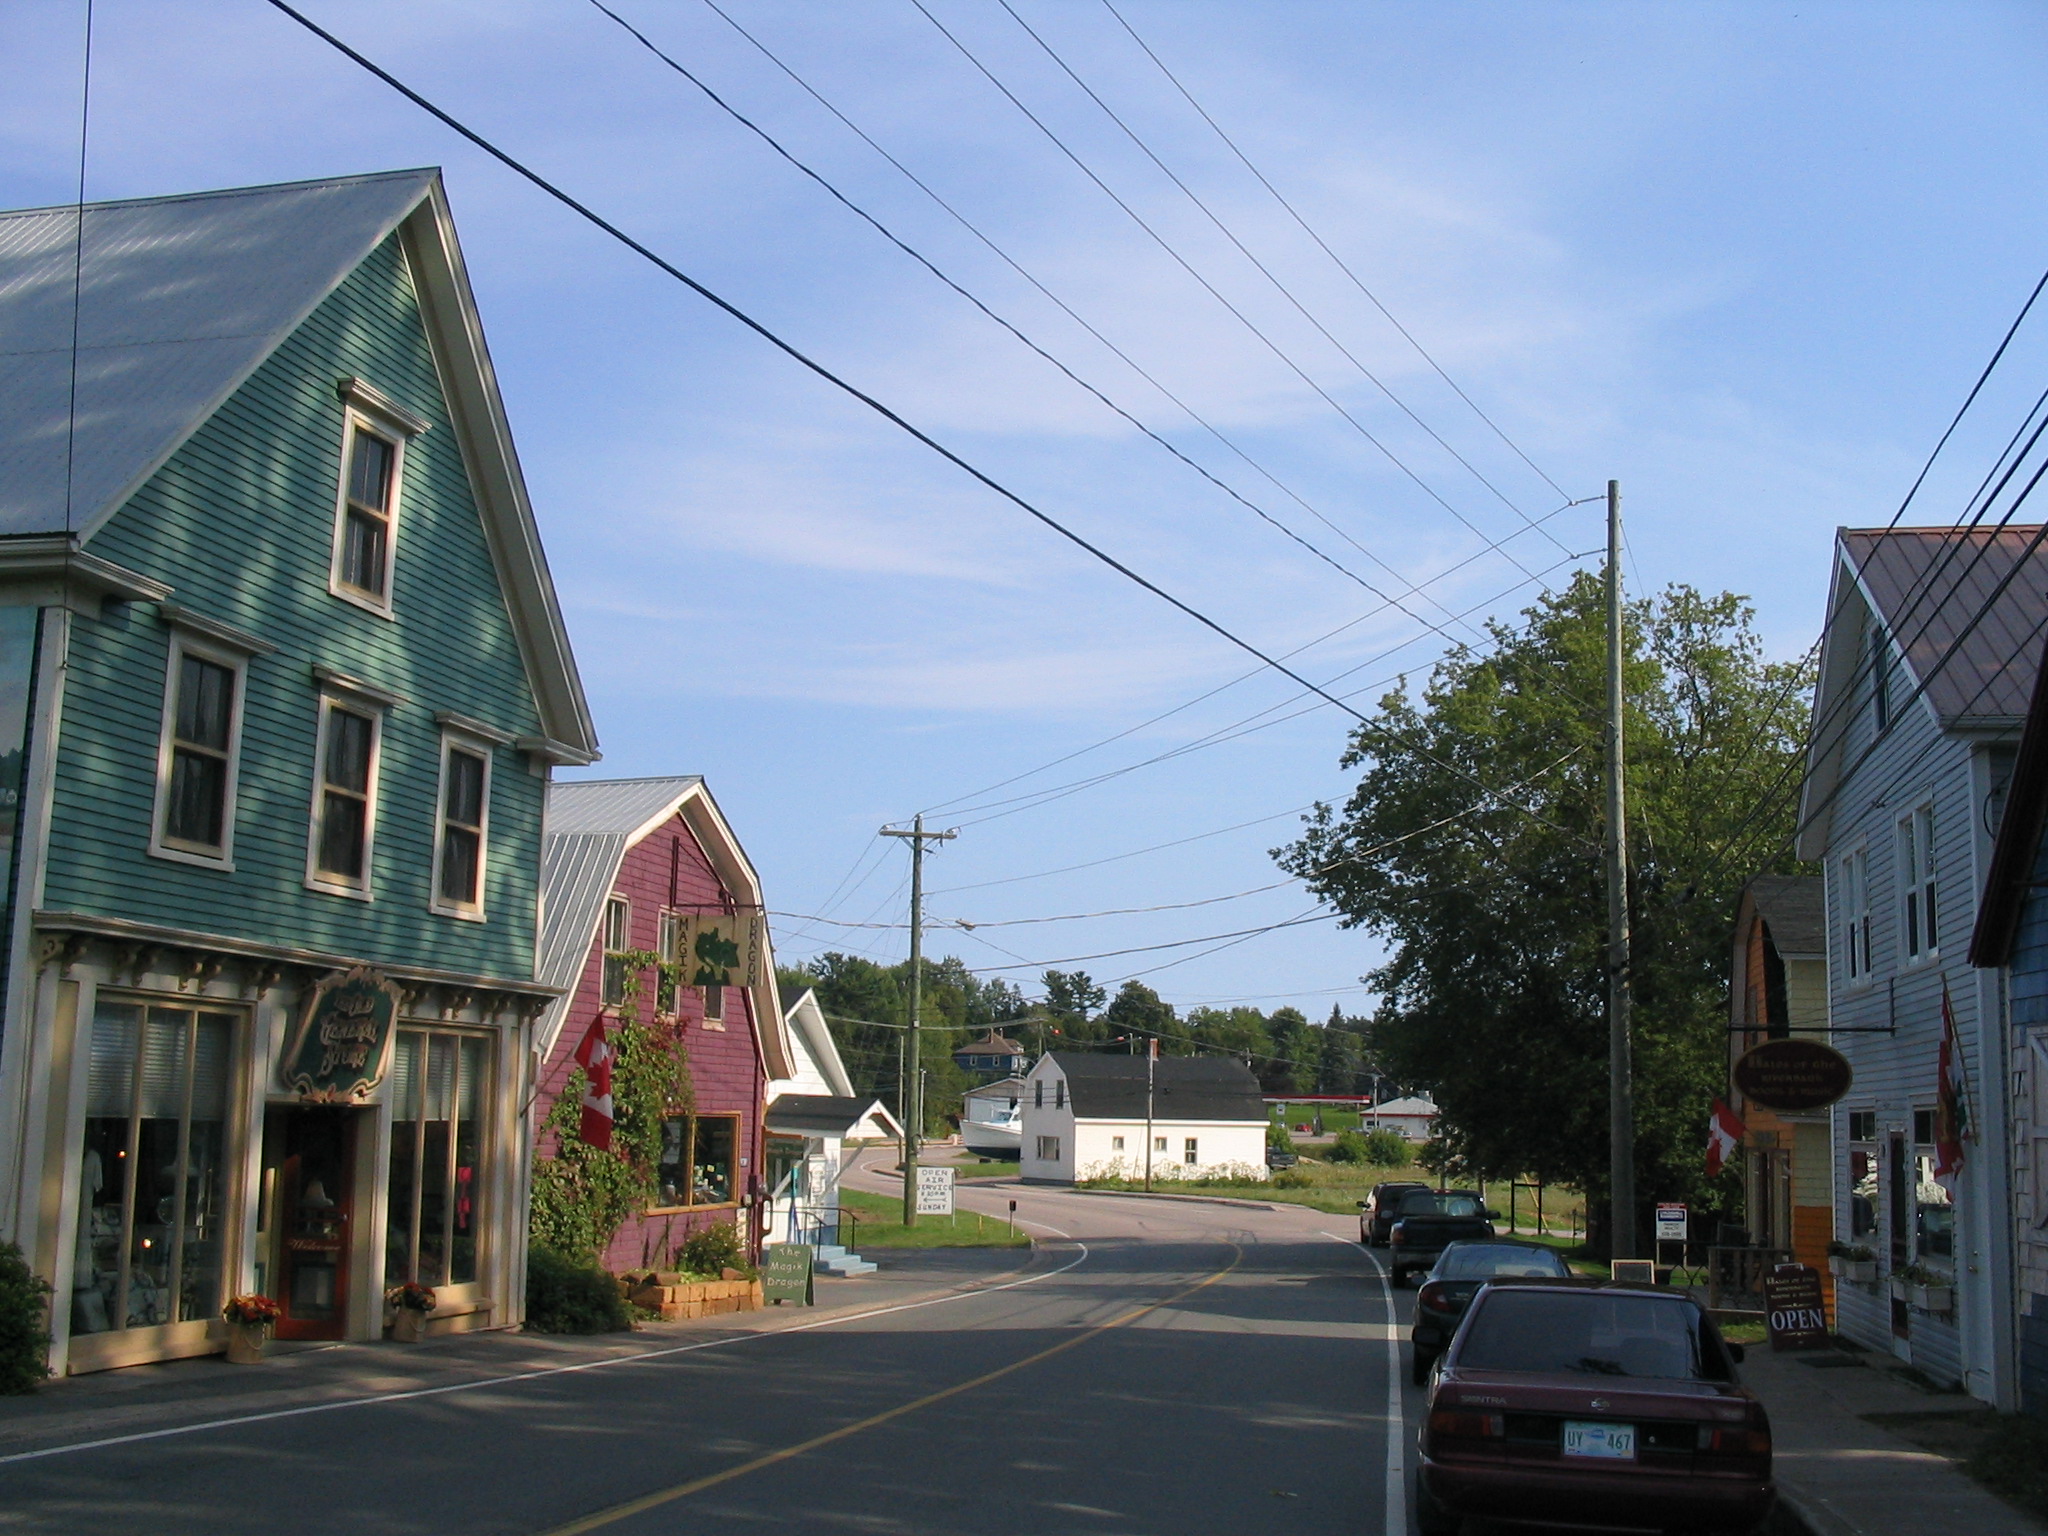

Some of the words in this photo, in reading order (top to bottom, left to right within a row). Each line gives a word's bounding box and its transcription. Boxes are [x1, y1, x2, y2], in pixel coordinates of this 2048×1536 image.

[678, 917, 689, 982] MAGIK
[746, 916, 758, 986] DRAGON
[917, 1203, 946, 1211] SUNDAY
[779, 1246, 801, 1257] The
[770, 1261, 803, 1273] Magik
[767, 1277, 805, 1289] Dragon
[1771, 1308, 1824, 1331] OPEN
[1460, 1394, 1508, 1405] SENTRA
[1567, 1431, 1583, 1447] UY
[1607, 1433, 1631, 1450] 467
